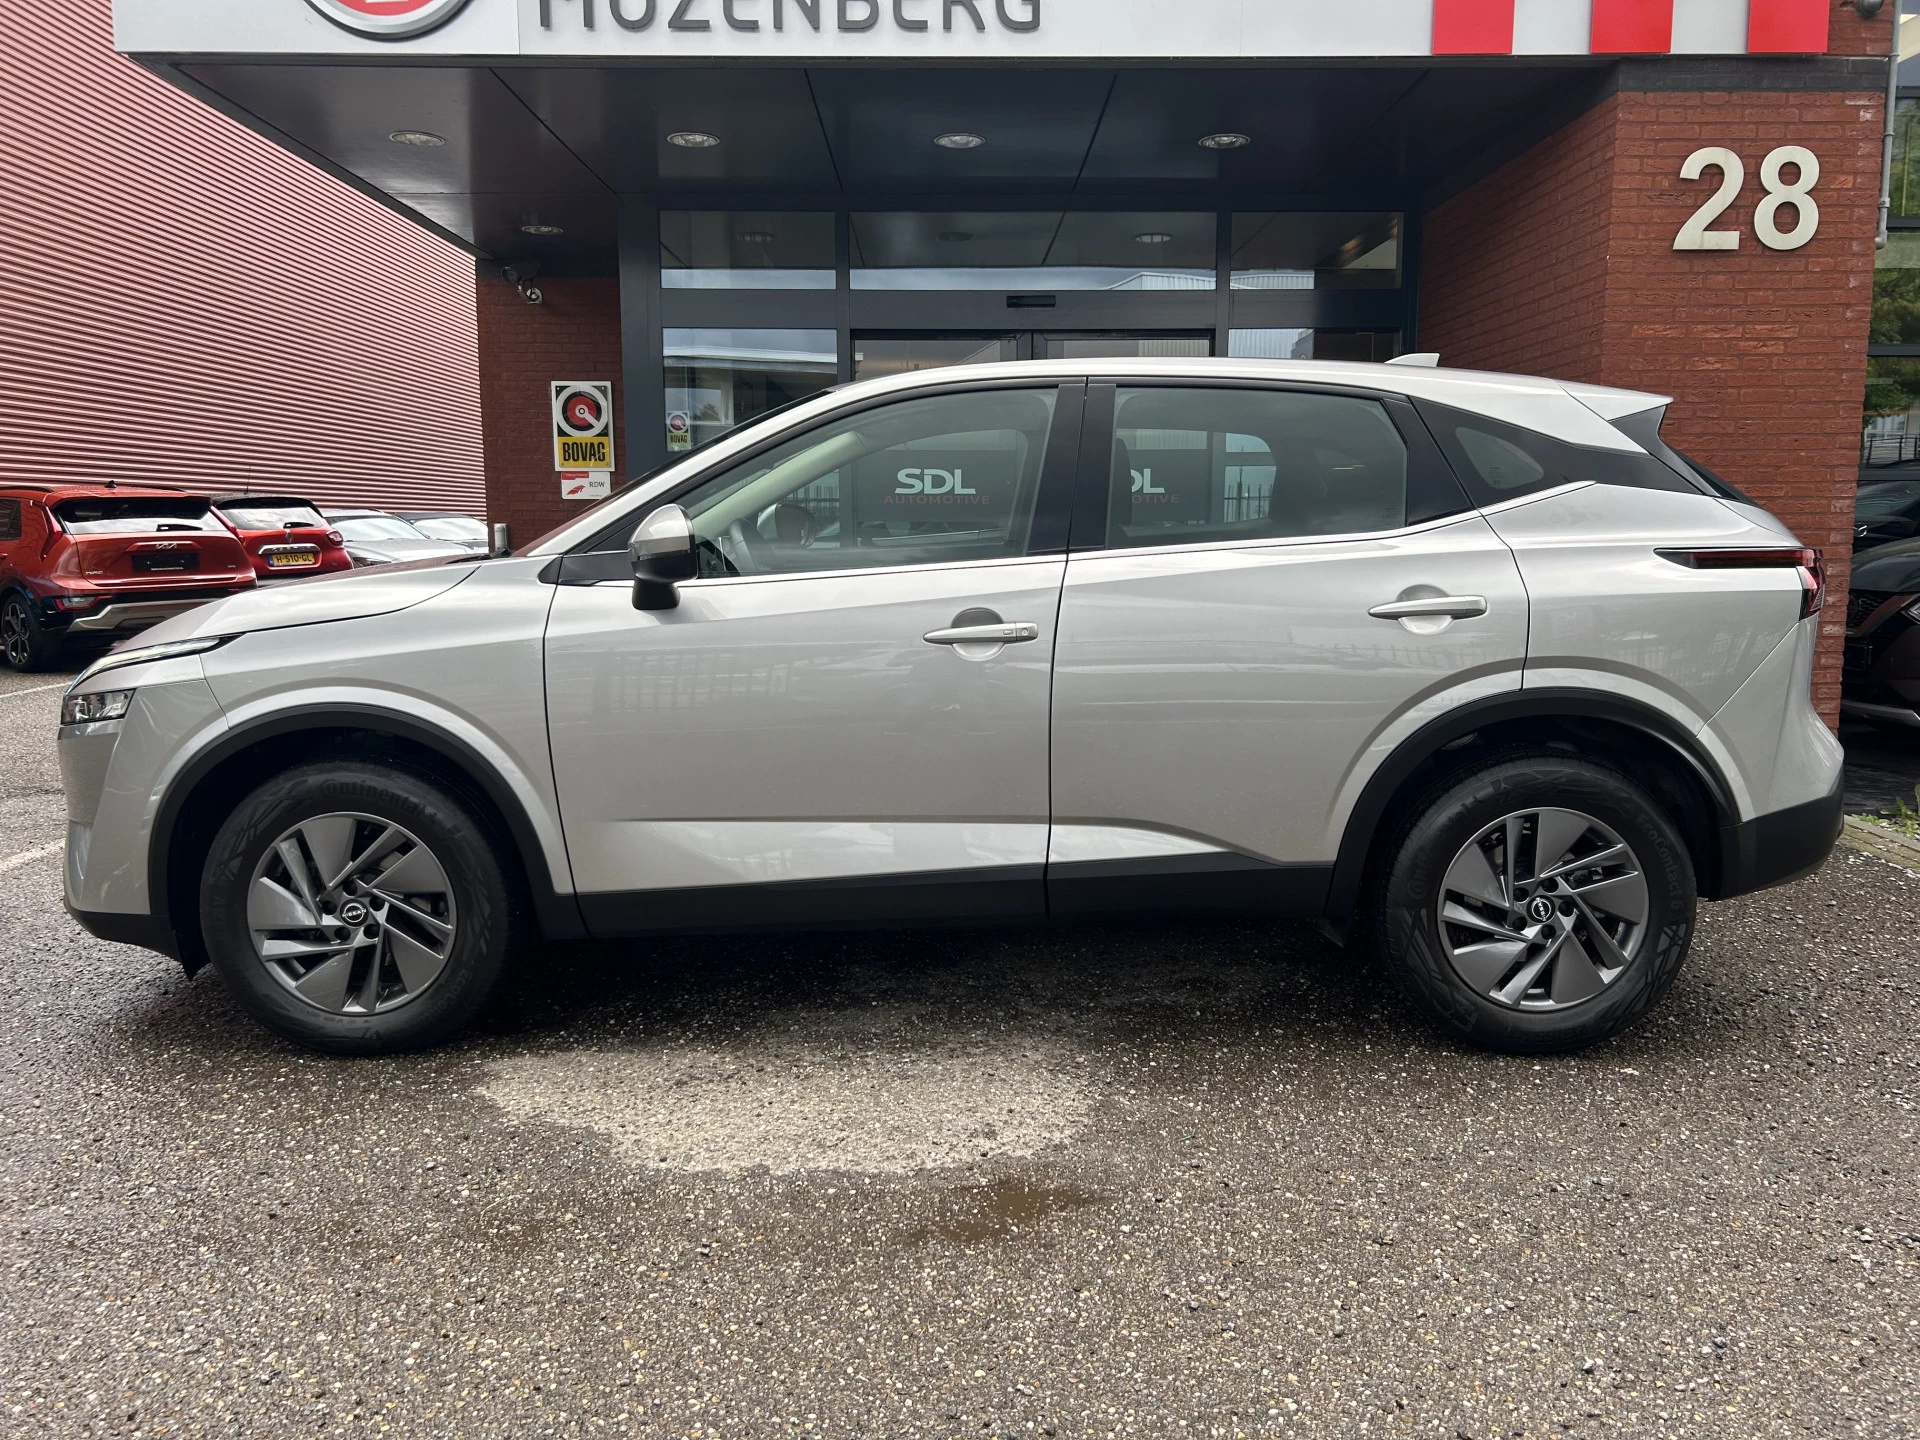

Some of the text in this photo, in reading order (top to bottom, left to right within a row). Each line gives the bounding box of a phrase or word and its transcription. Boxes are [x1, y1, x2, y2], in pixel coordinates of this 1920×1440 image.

[1673, 145, 1820, 250] 28
[670, 434, 688, 443] BOVAG
[562, 441, 606, 462] BOVAG
[894, 468, 977, 494] SDL
[883, 495, 991, 505] AUTOMOTIVE
[276, 554, 312, 563] H-510-GL
[341, 908, 367, 918] NISSAN
